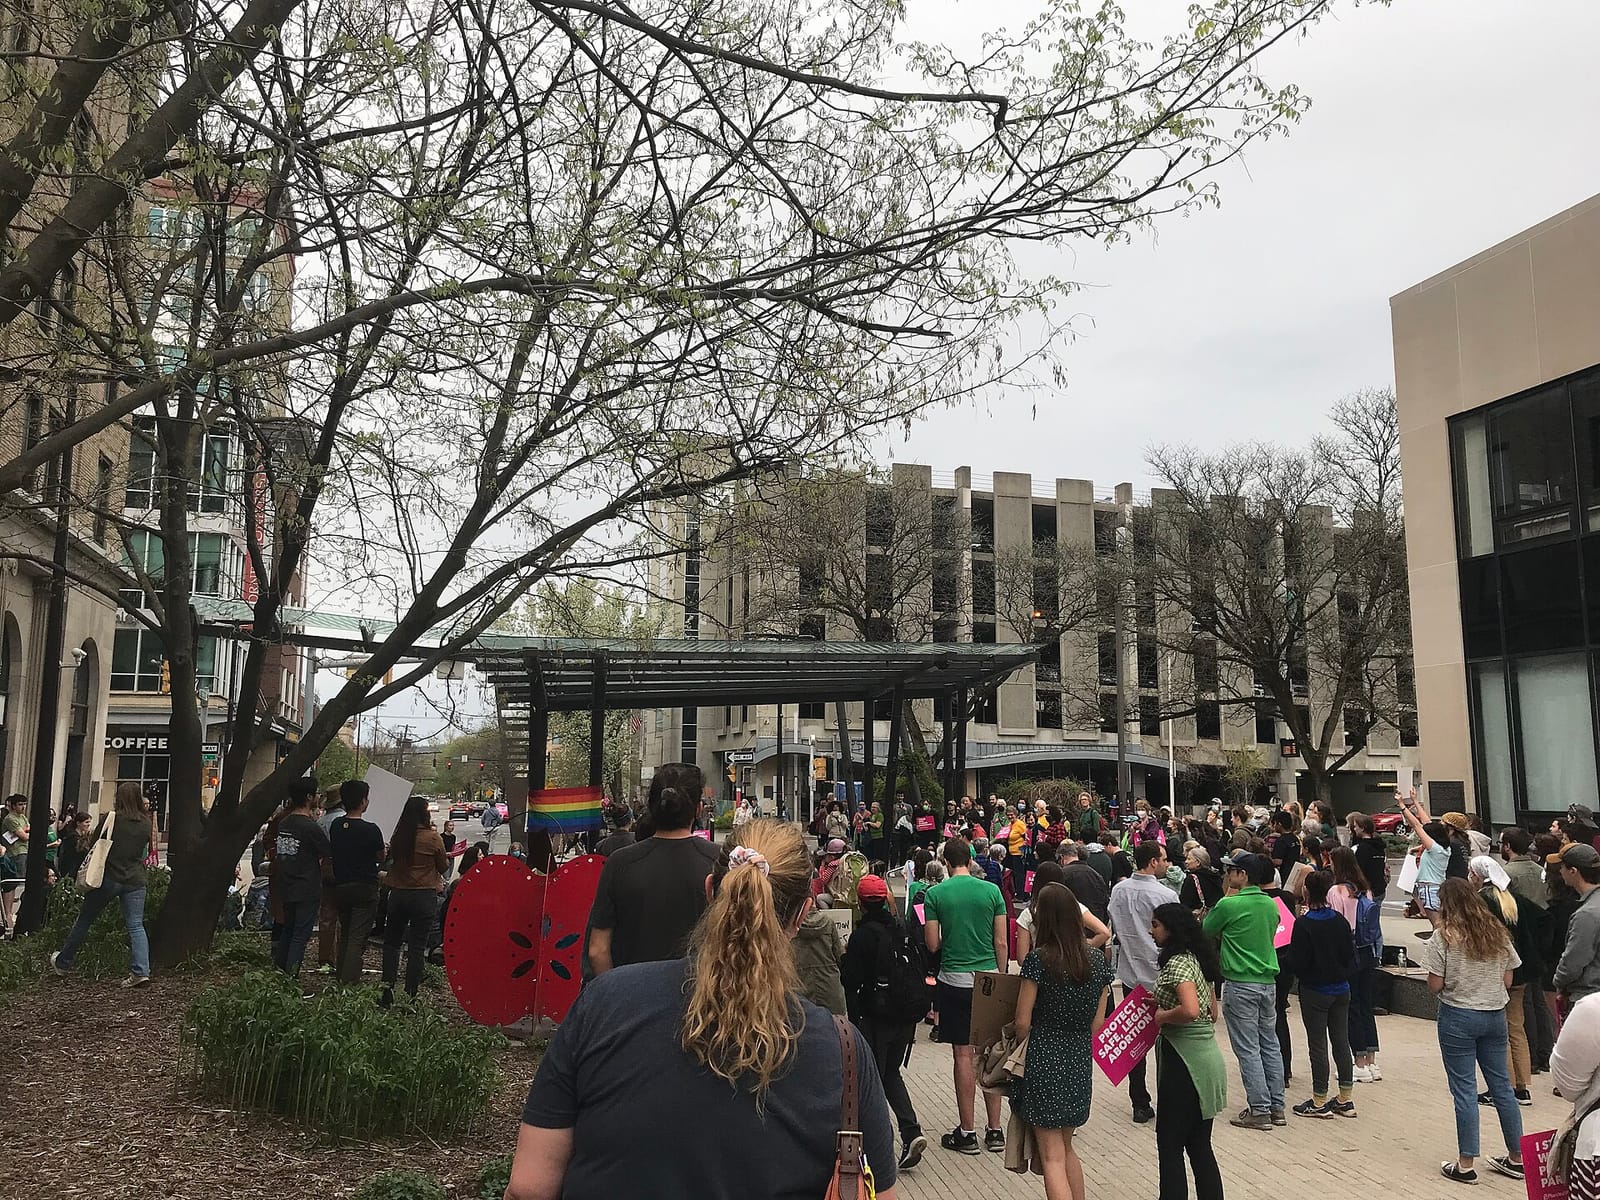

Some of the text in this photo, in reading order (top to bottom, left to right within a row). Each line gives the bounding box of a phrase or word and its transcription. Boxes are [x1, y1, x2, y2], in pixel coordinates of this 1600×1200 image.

[104, 737, 168, 749] COFFEE
[1098, 1000, 1136, 1043] PROTECT
[1098, 1033, 1124, 1059] SAFE,
[1121, 1002, 1150, 1033] LEGAL
[1108, 1013, 1153, 1064] ABORTION
